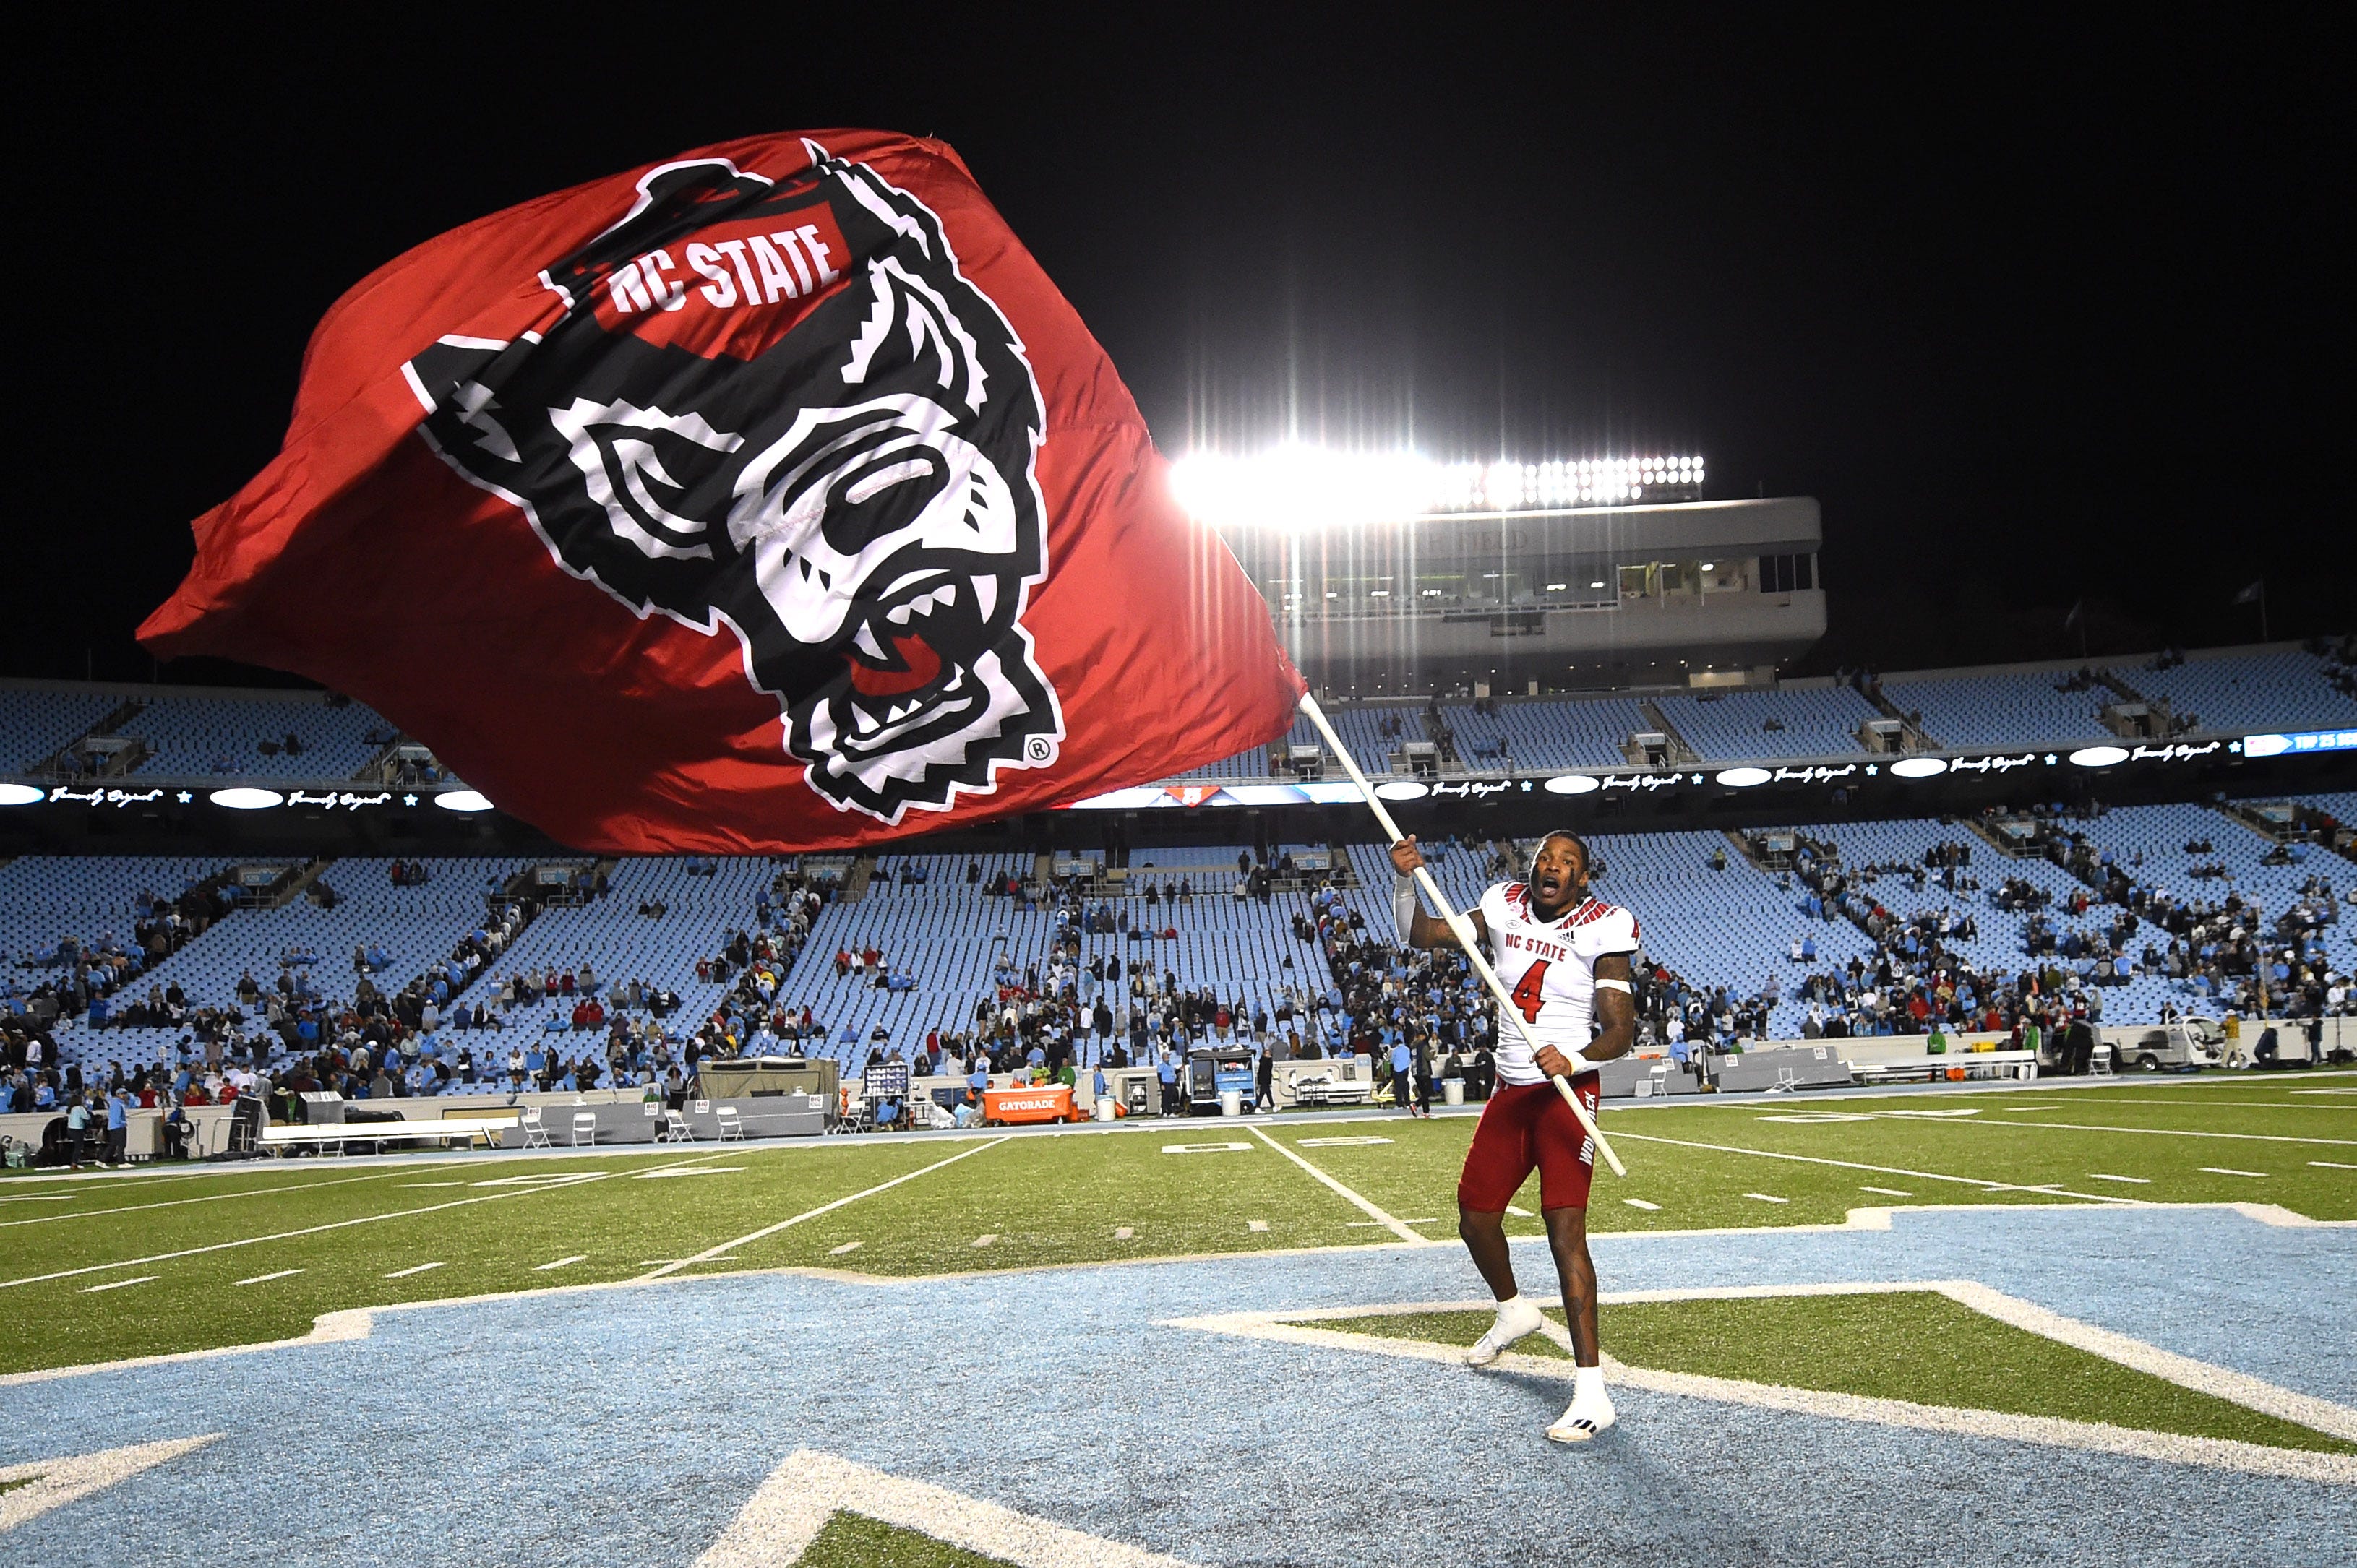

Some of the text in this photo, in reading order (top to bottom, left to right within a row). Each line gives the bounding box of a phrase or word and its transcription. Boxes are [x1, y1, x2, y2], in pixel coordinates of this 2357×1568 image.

[607, 224, 839, 312] NC STATE
[1506, 933, 1567, 962] NC STATE
[1510, 958, 1552, 1025] 4
[998, 1099, 1055, 1111] GATORADE
